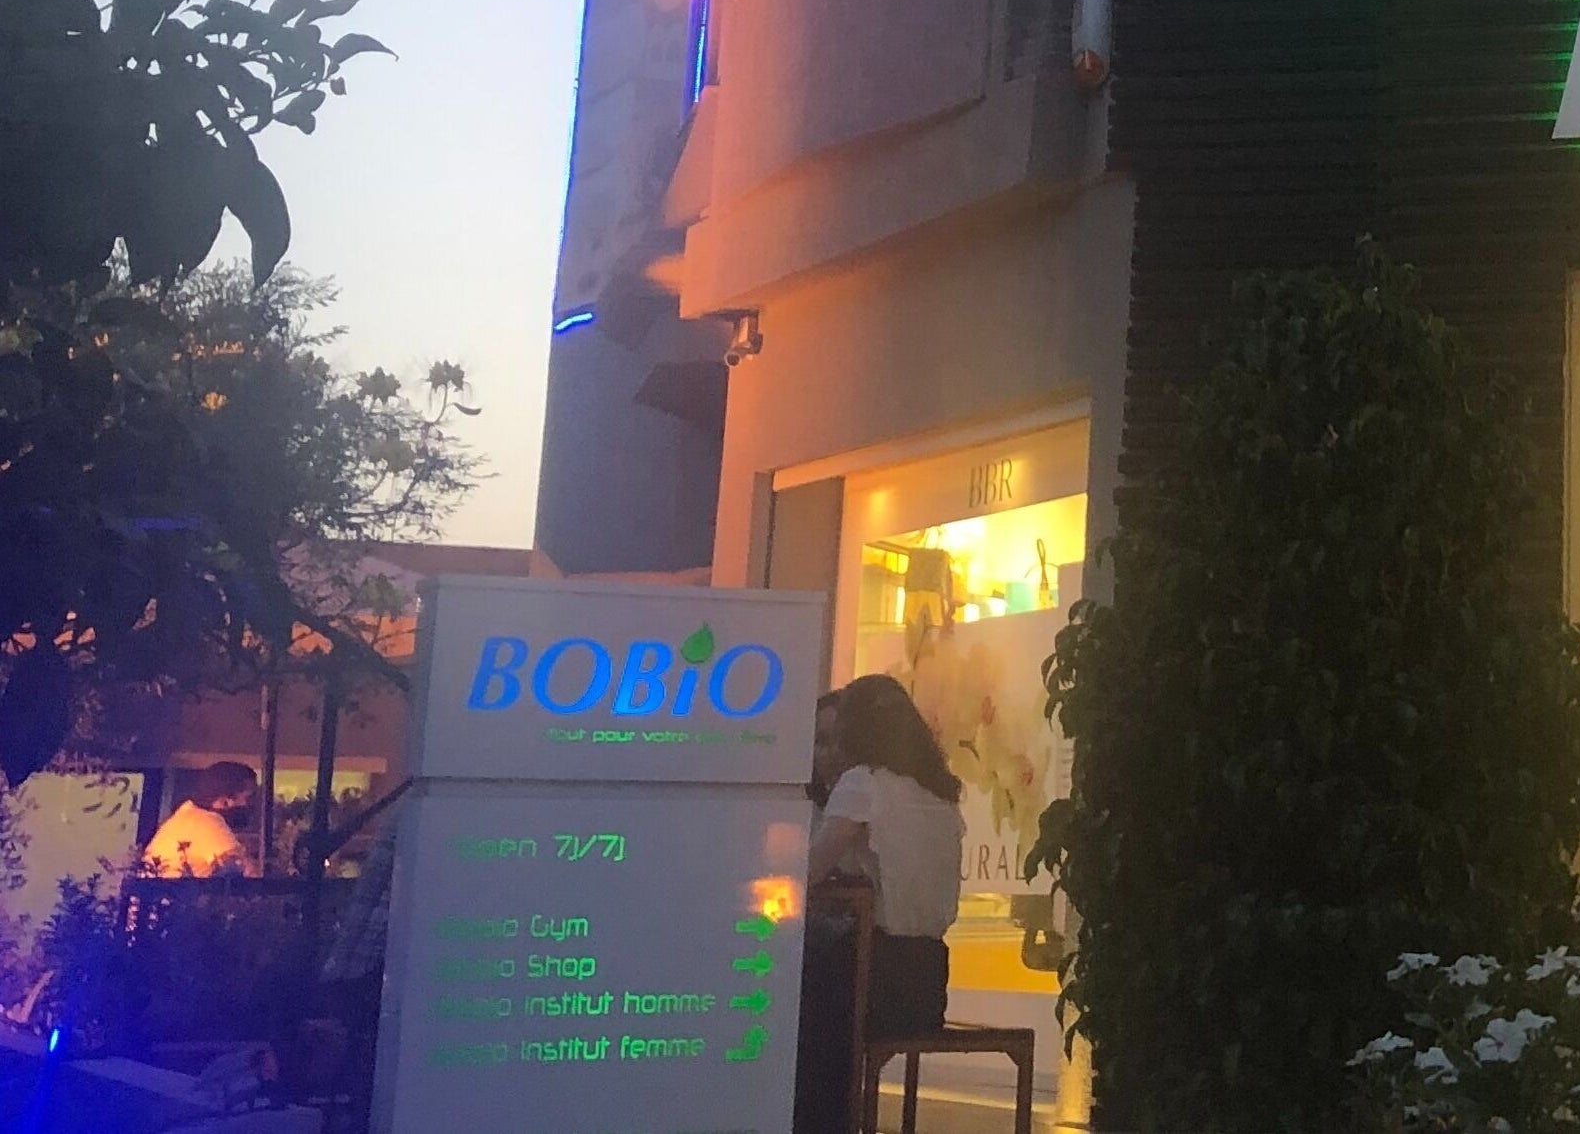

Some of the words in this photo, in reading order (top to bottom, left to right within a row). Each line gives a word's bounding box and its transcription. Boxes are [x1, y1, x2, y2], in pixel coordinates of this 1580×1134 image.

[969, 458, 1012, 508] BBR
[465, 622, 784, 719] BOBiO
[593, 730, 635, 743] pour
[642, 731, 689, 743] votre
[530, 914, 589, 942] Gym
[528, 954, 597, 981] Shop
[623, 991, 716, 1014] homme
[620, 1035, 705, 1059] femme
